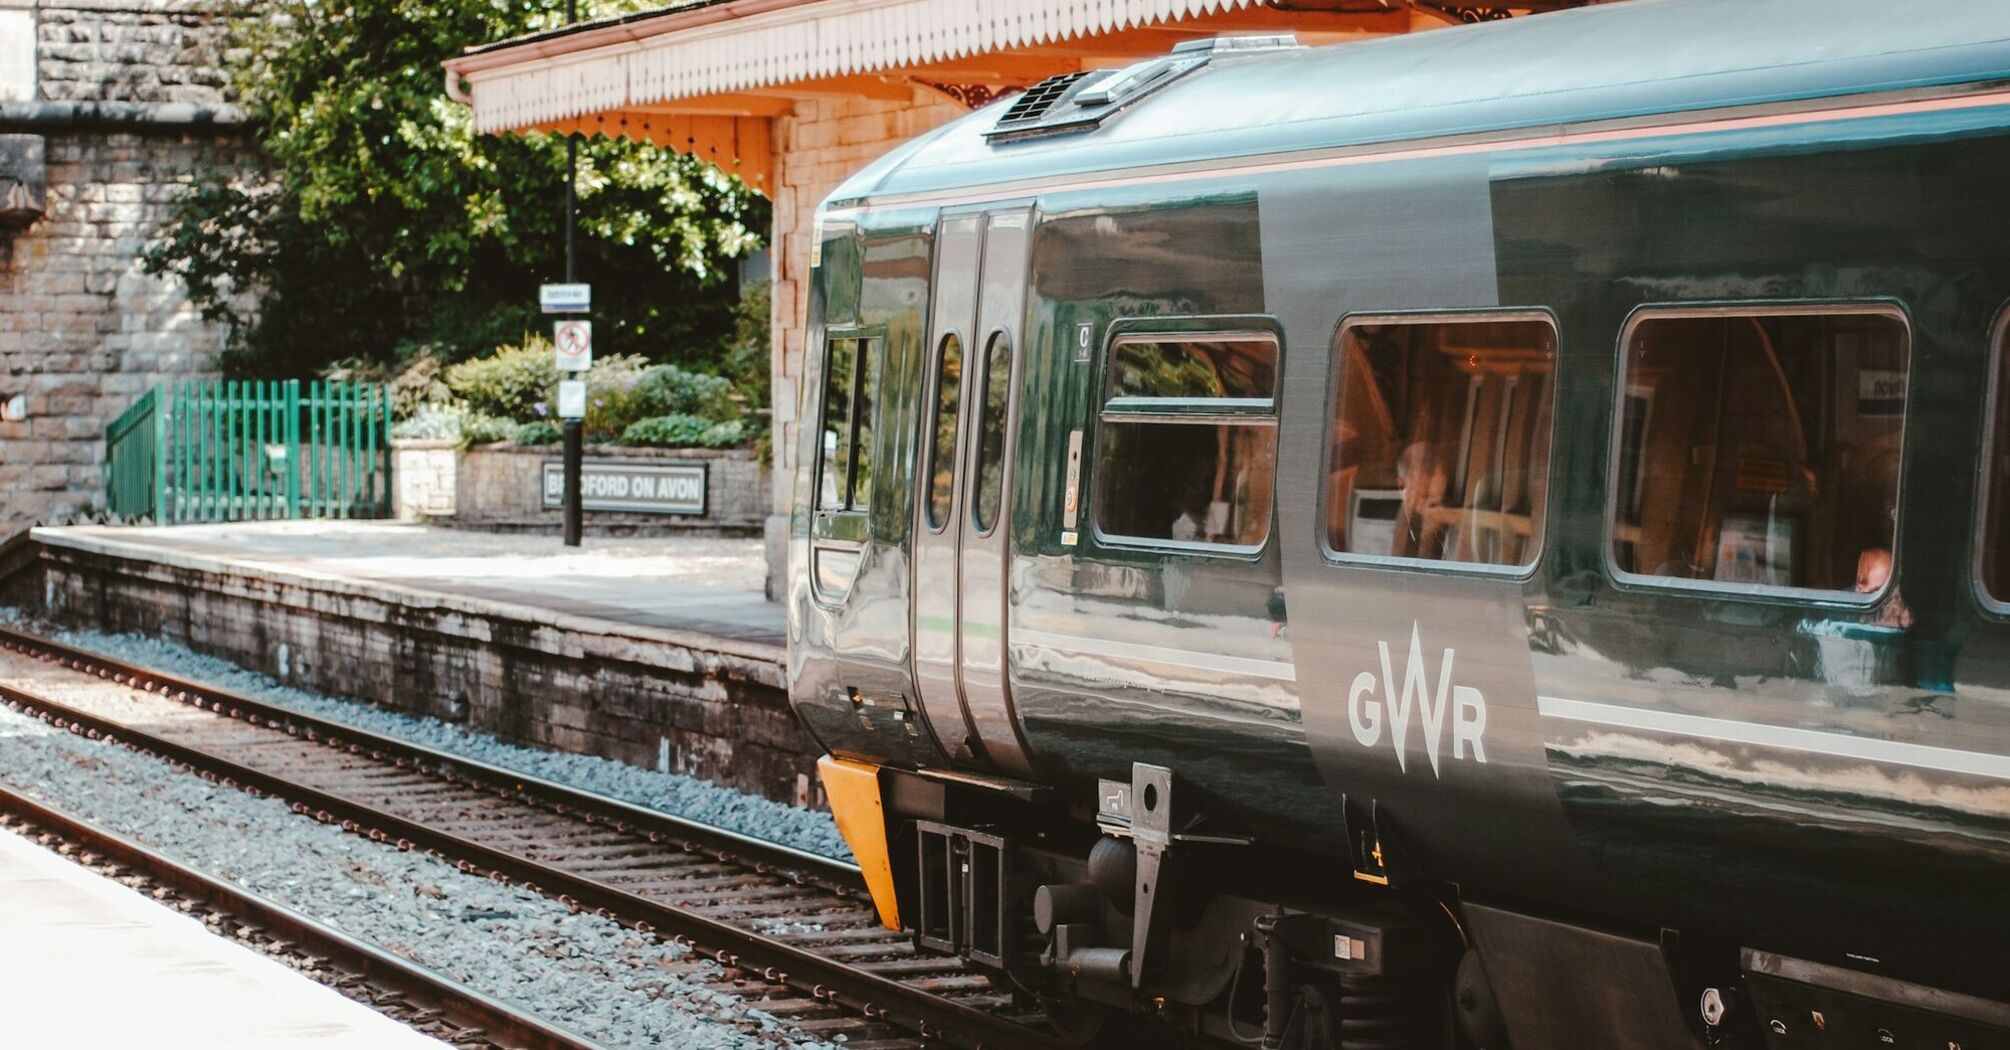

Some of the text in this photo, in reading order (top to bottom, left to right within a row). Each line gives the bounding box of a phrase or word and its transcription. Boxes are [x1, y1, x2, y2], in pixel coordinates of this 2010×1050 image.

[1080, 327, 1089, 348] C
[631, 475, 655, 498] ON
[657, 477, 699, 499] AVON
[1348, 619, 1487, 780] GWR
